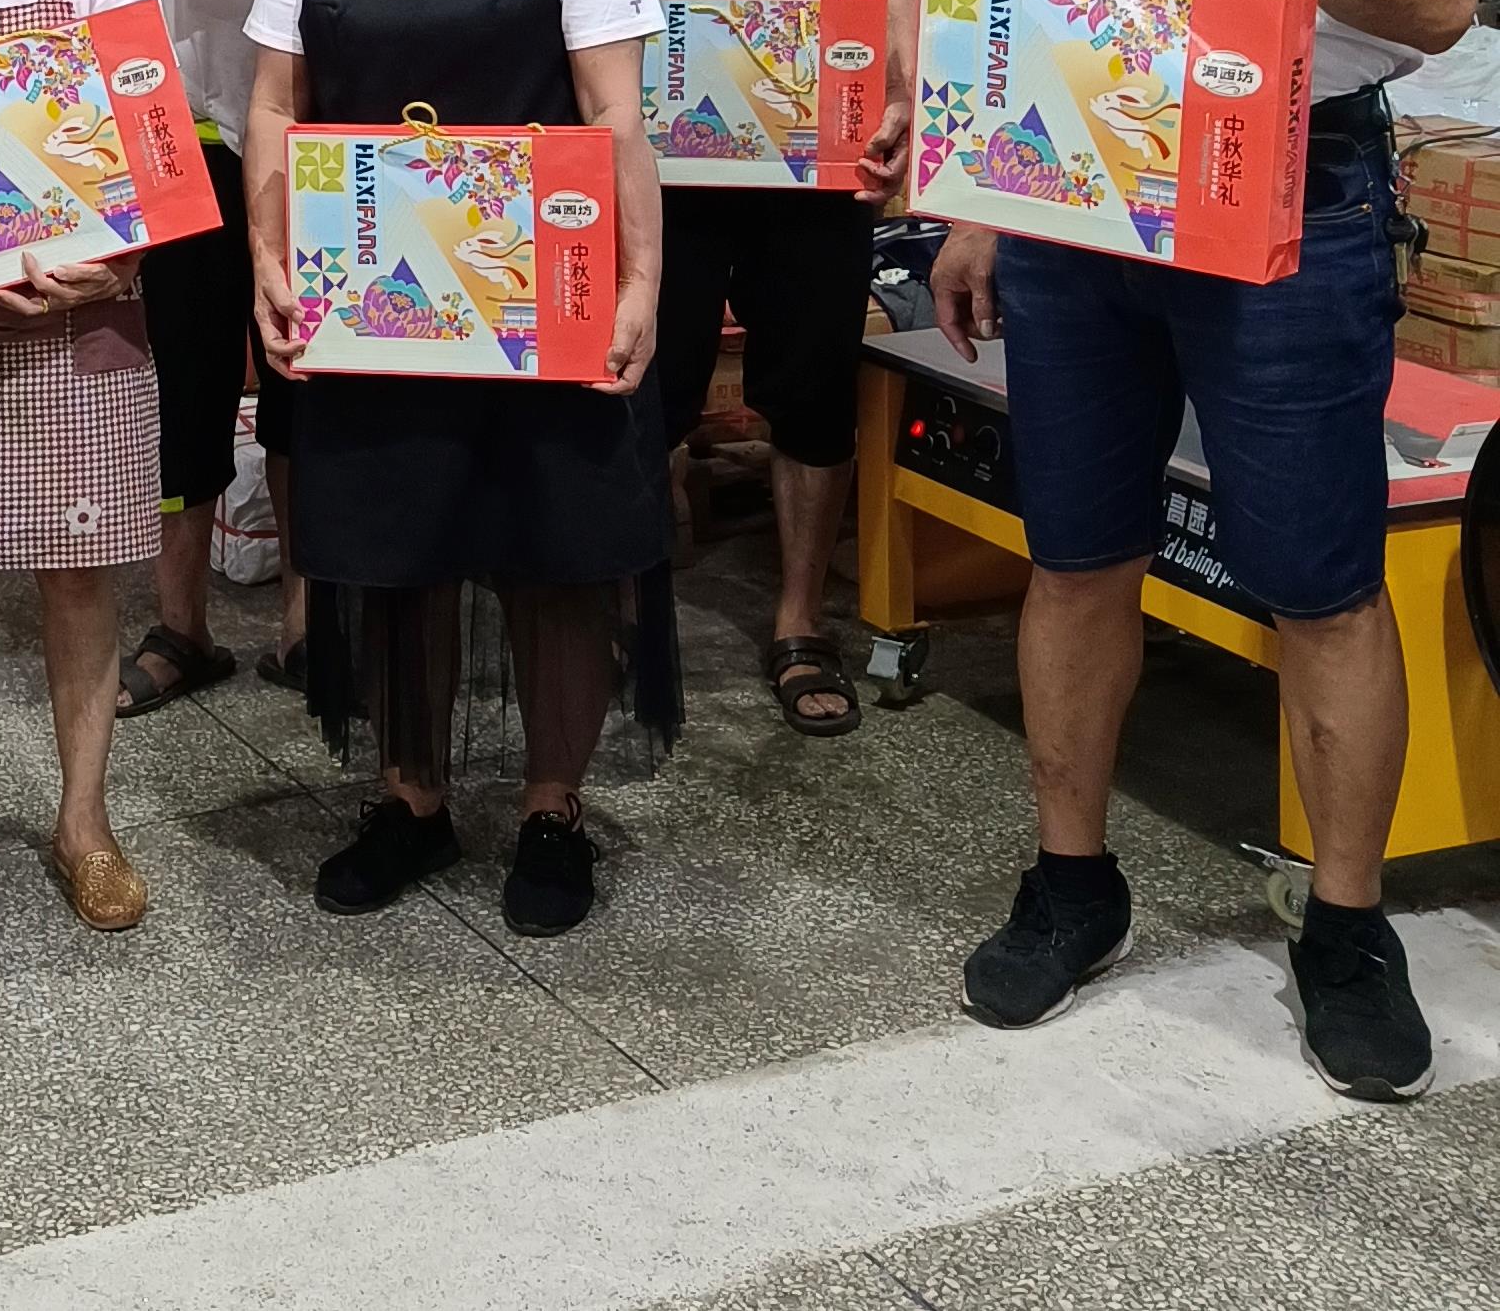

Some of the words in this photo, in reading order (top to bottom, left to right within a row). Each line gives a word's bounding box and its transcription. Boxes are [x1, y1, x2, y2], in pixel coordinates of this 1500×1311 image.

[149, 104, 184, 178] 中秋华礼
[1218, 114, 1245, 207] 中秋华礼
[570, 241, 591, 321] 中秋华礼
[1174, 539, 1222, 585] baling
